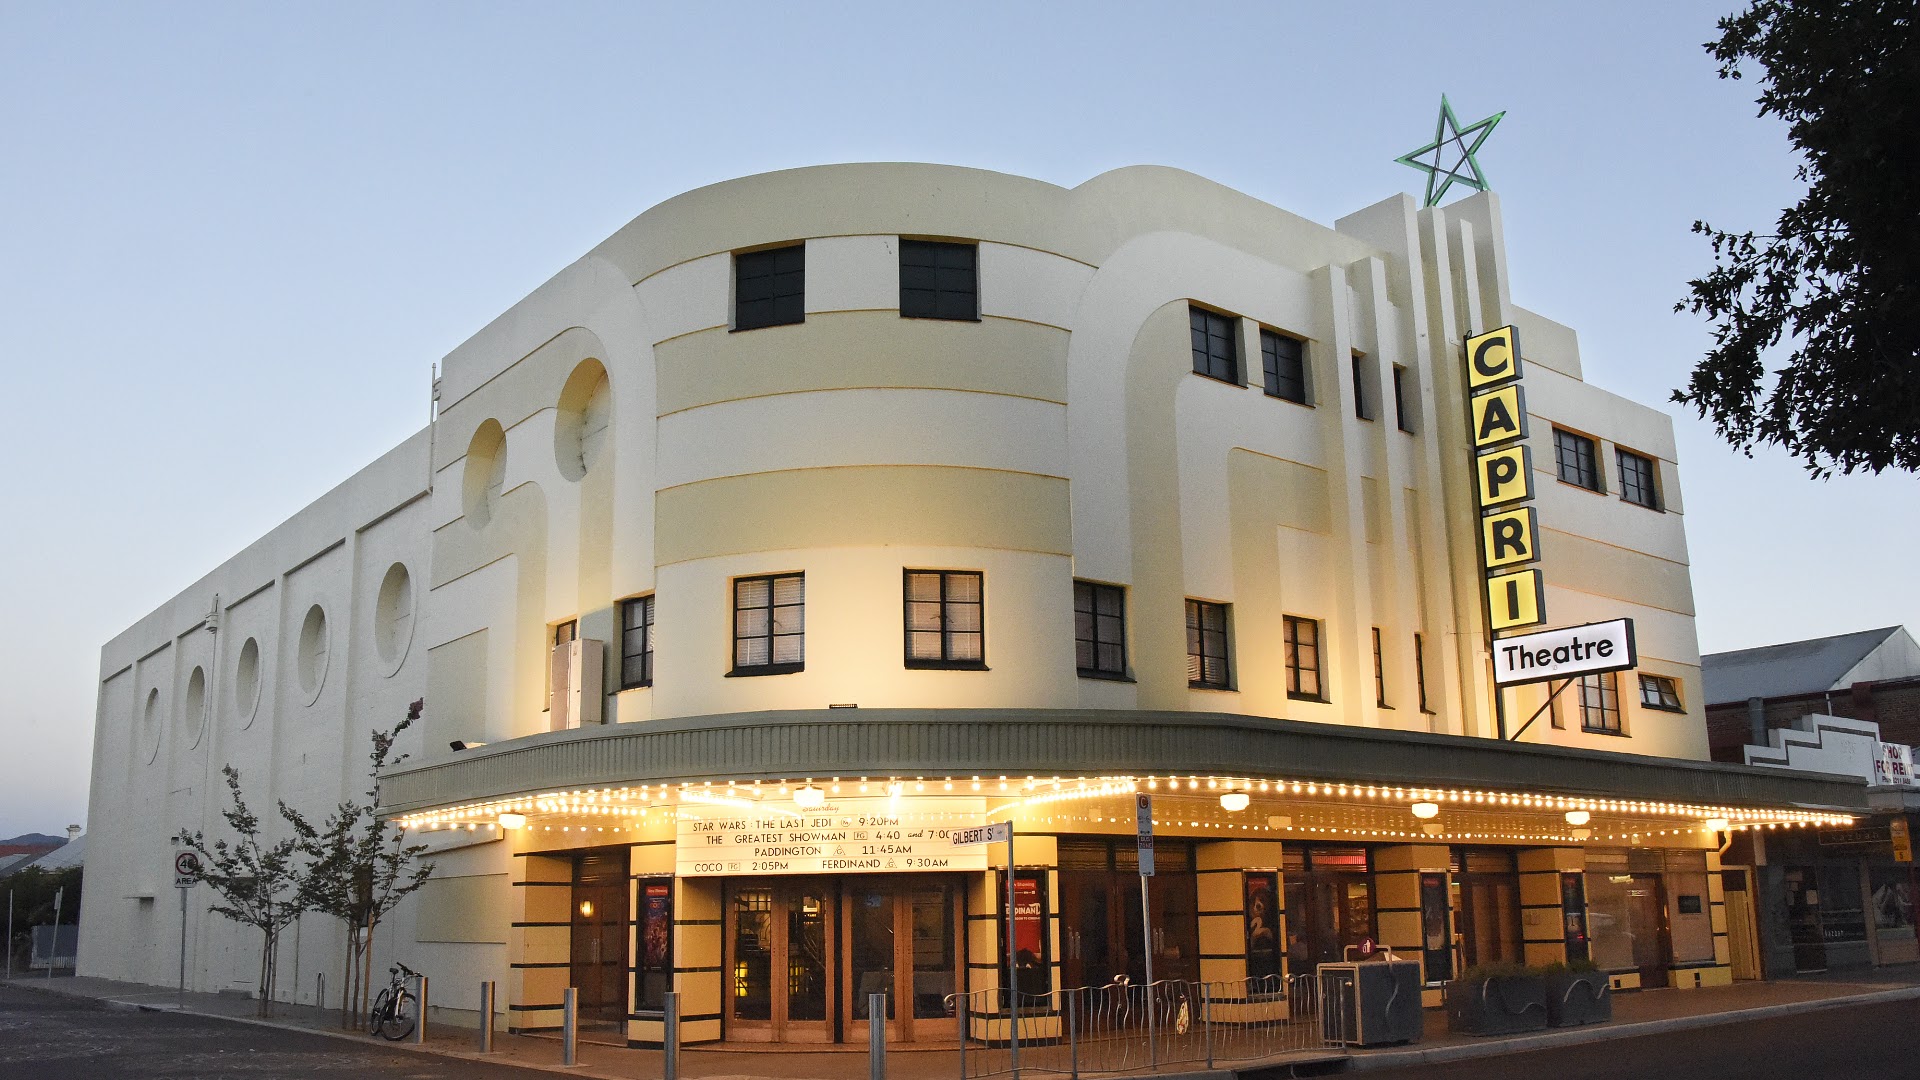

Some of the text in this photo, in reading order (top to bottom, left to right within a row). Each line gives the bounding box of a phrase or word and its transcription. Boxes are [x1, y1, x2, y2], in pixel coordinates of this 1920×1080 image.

[1473, 335, 1527, 621] CAPRI
[1502, 636, 1614, 672] Theatre
[693, 821, 714, 832] STAR
[719, 820, 746, 830] WARS
[756, 819, 775, 830] THE
[780, 818, 805, 829] LAST
[810, 817, 832, 828] JEDI
[858, 816, 899, 827] 9:20PM
[706, 835, 723, 845] THE
[734, 833, 784, 844] GREATEST
[789, 831, 846, 842] SHOWMAN
[875, 830, 901, 840] 4:40
[907, 829, 924, 838] and
[952, 828, 984, 845] GILBERT
[754, 846, 822, 857] PADDINGTON
[862, 844, 912, 855] 11:45AM
[694, 862, 723, 873] COCO
[752, 861, 789, 871] 2:05PM
[822, 859, 881, 869] FERDINAND
[906, 858, 949, 868] 9:30AM
[176, 877, 197, 885] AREA
